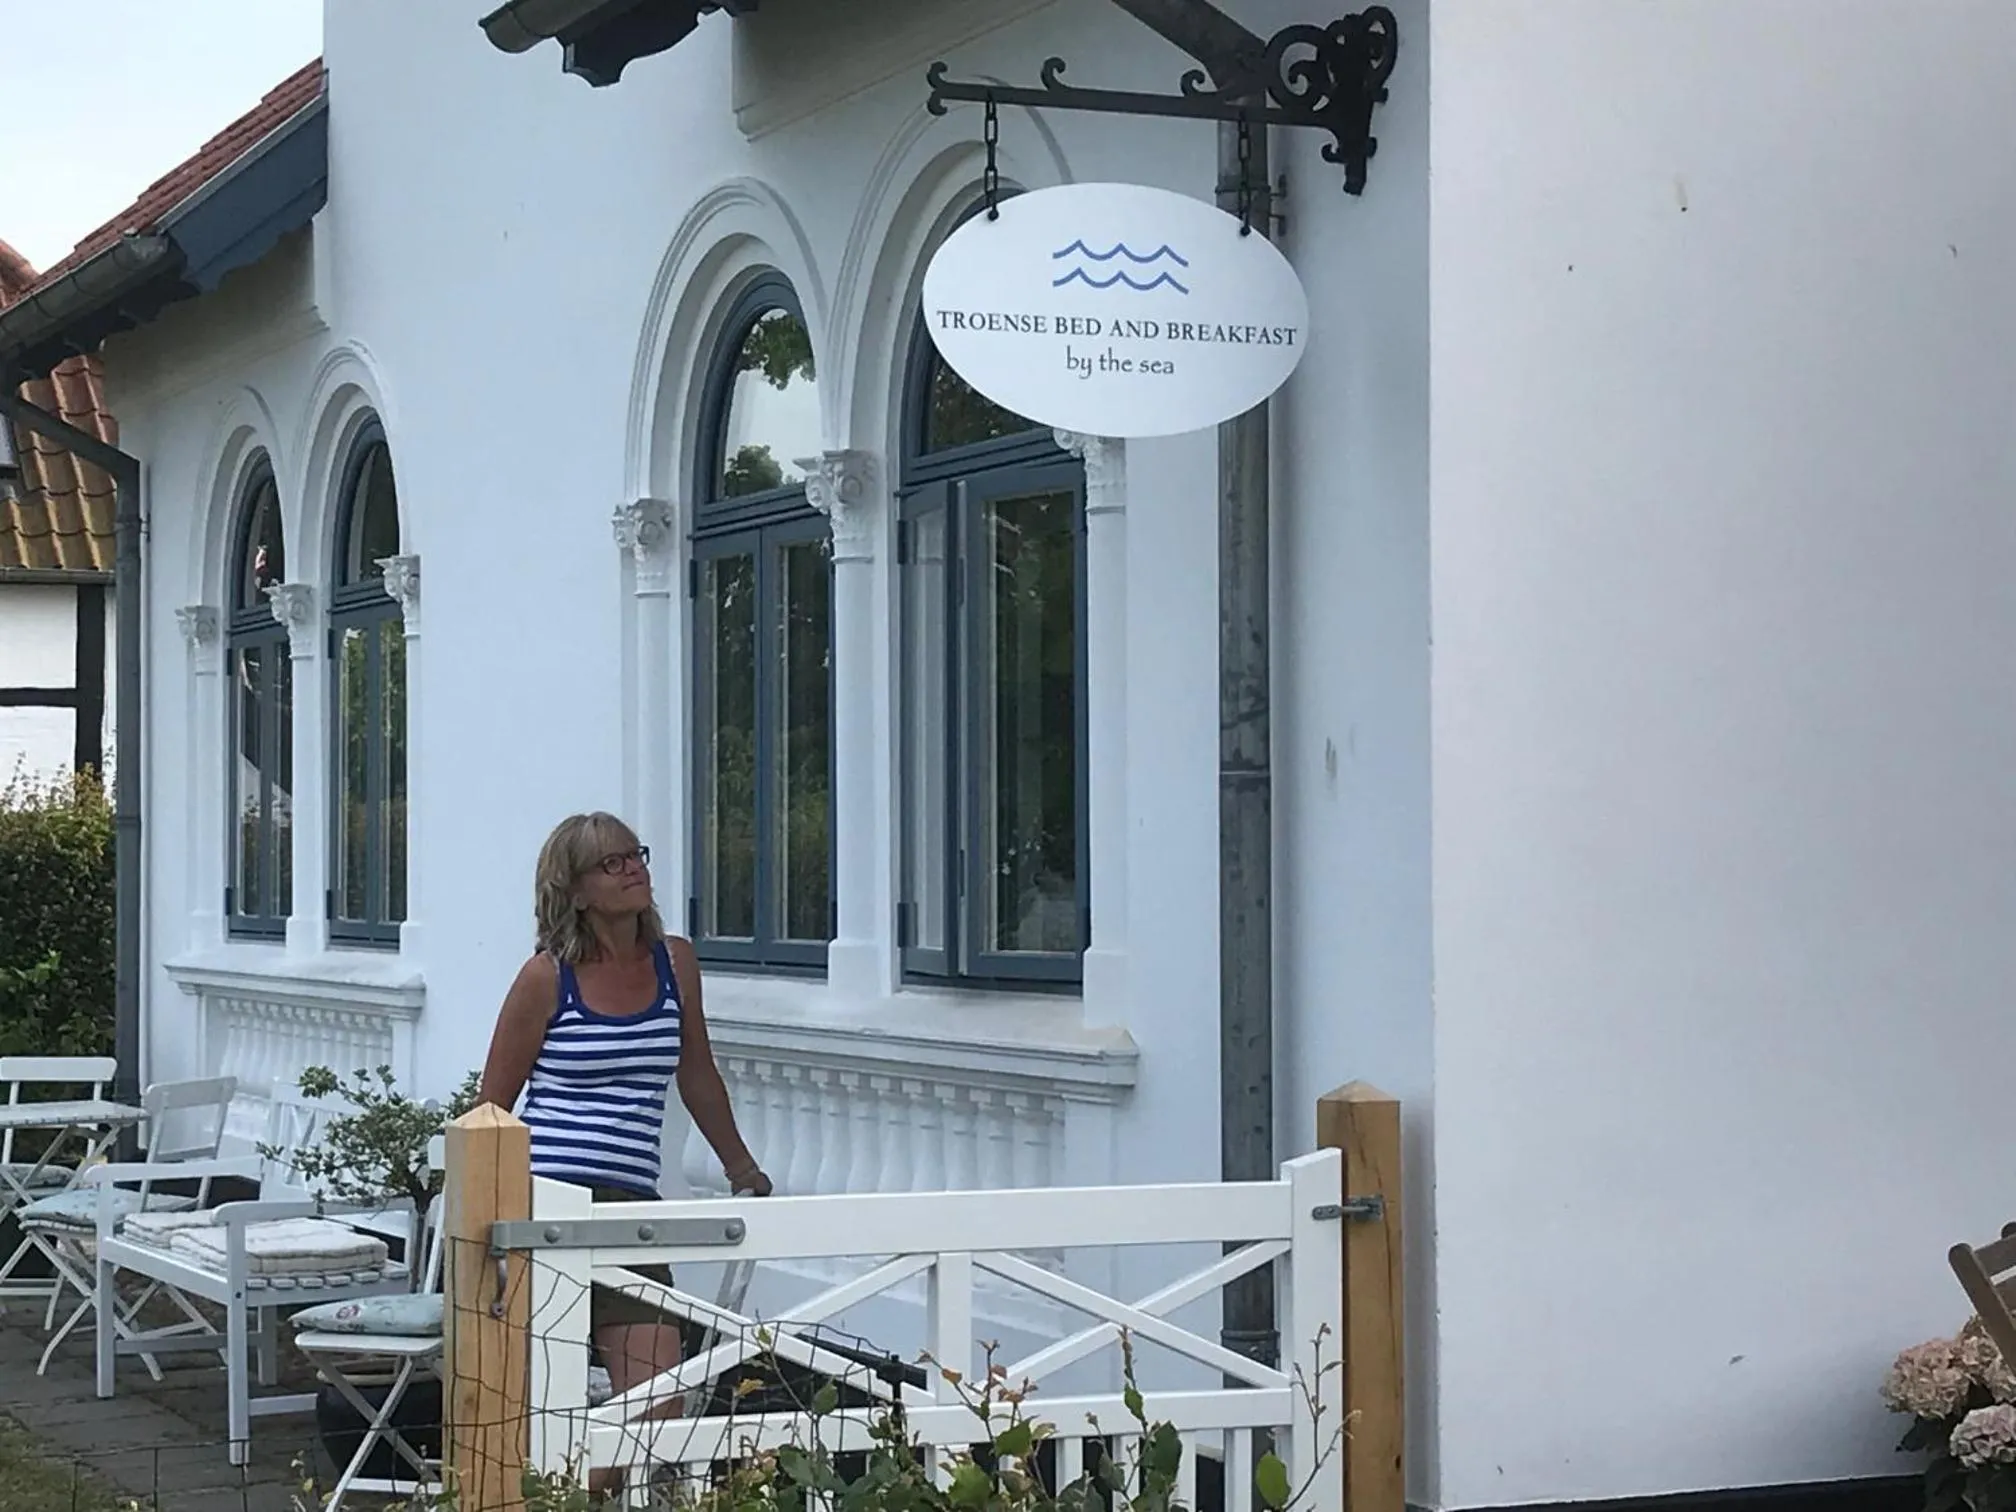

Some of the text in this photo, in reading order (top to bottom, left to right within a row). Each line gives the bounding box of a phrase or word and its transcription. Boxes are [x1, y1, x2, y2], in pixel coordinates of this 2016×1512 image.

[937, 311, 1297, 346] TROENSE BED AND BREAKFAST
[1067, 345, 1174, 379] by the sea
